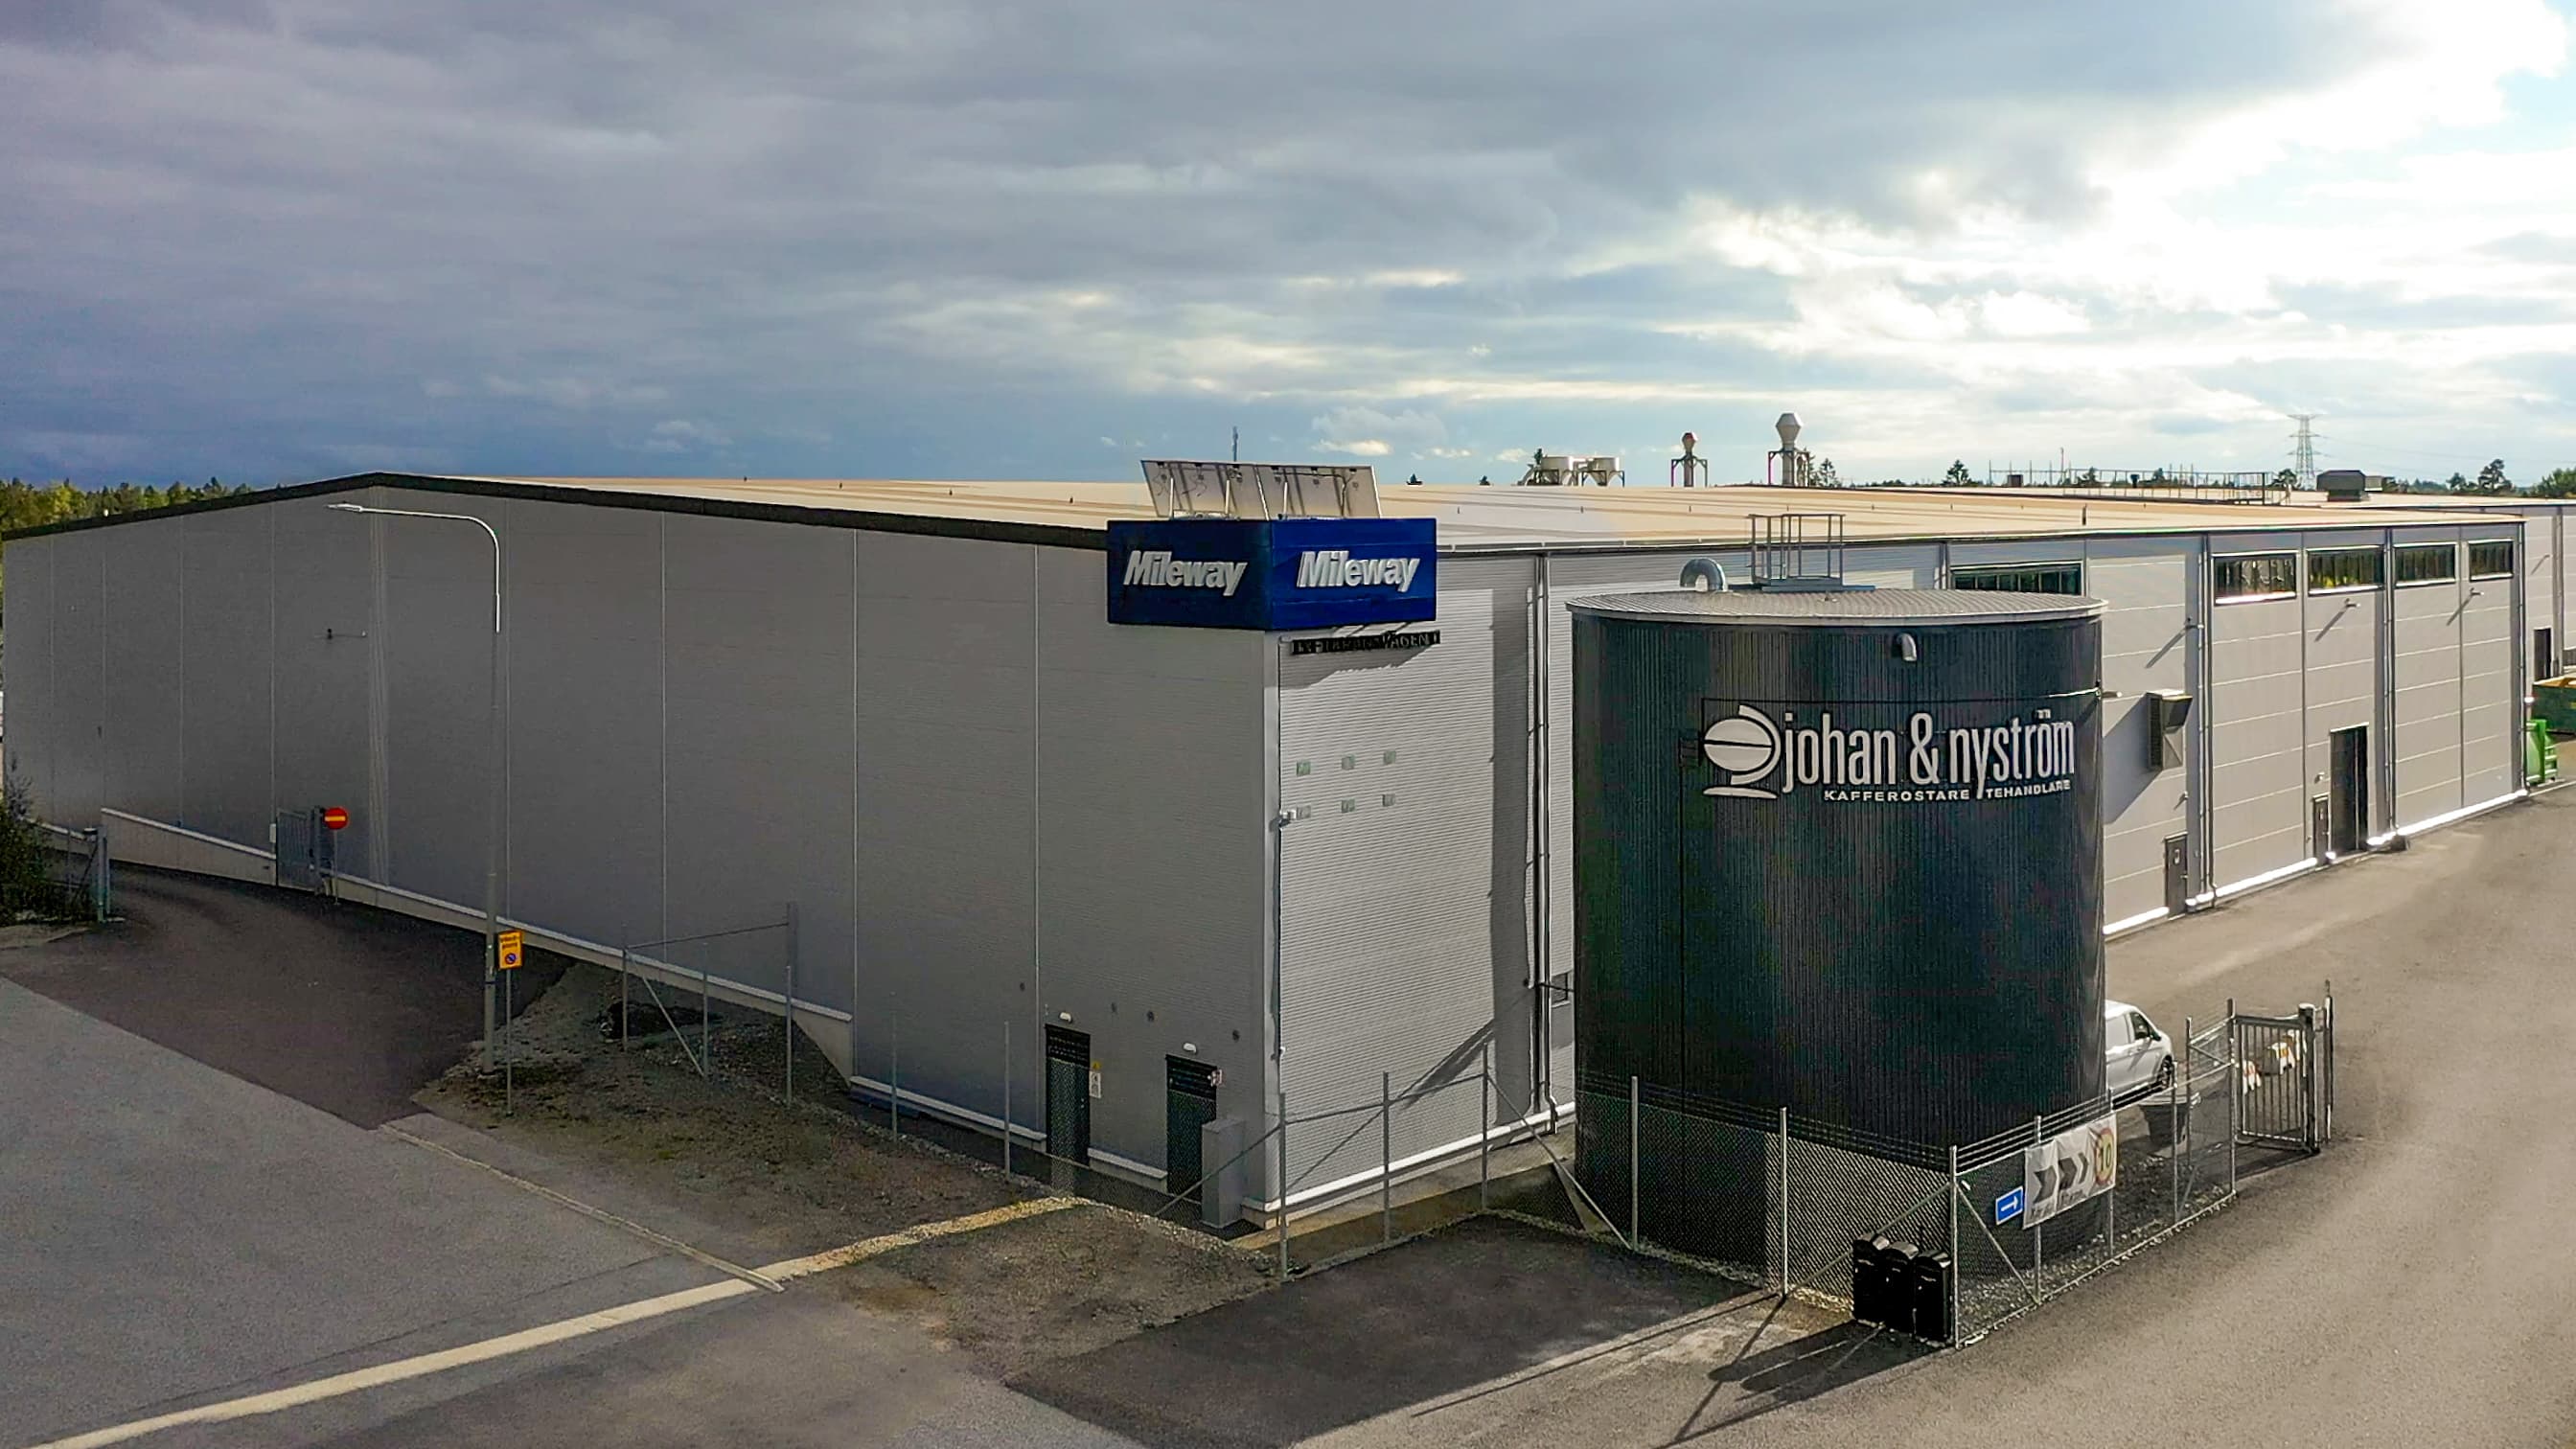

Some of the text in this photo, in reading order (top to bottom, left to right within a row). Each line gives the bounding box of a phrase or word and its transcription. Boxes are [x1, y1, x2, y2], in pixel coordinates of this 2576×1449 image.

[1123, 550, 1248, 597] Mileway
[1297, 549, 1421, 593] Mileway
[1782, 707, 2076, 799] johan & nyström
[1824, 780, 2071, 802] KAFFEROSTARE TEHANDLARE
[2097, 1143, 2112, 1172] 10
